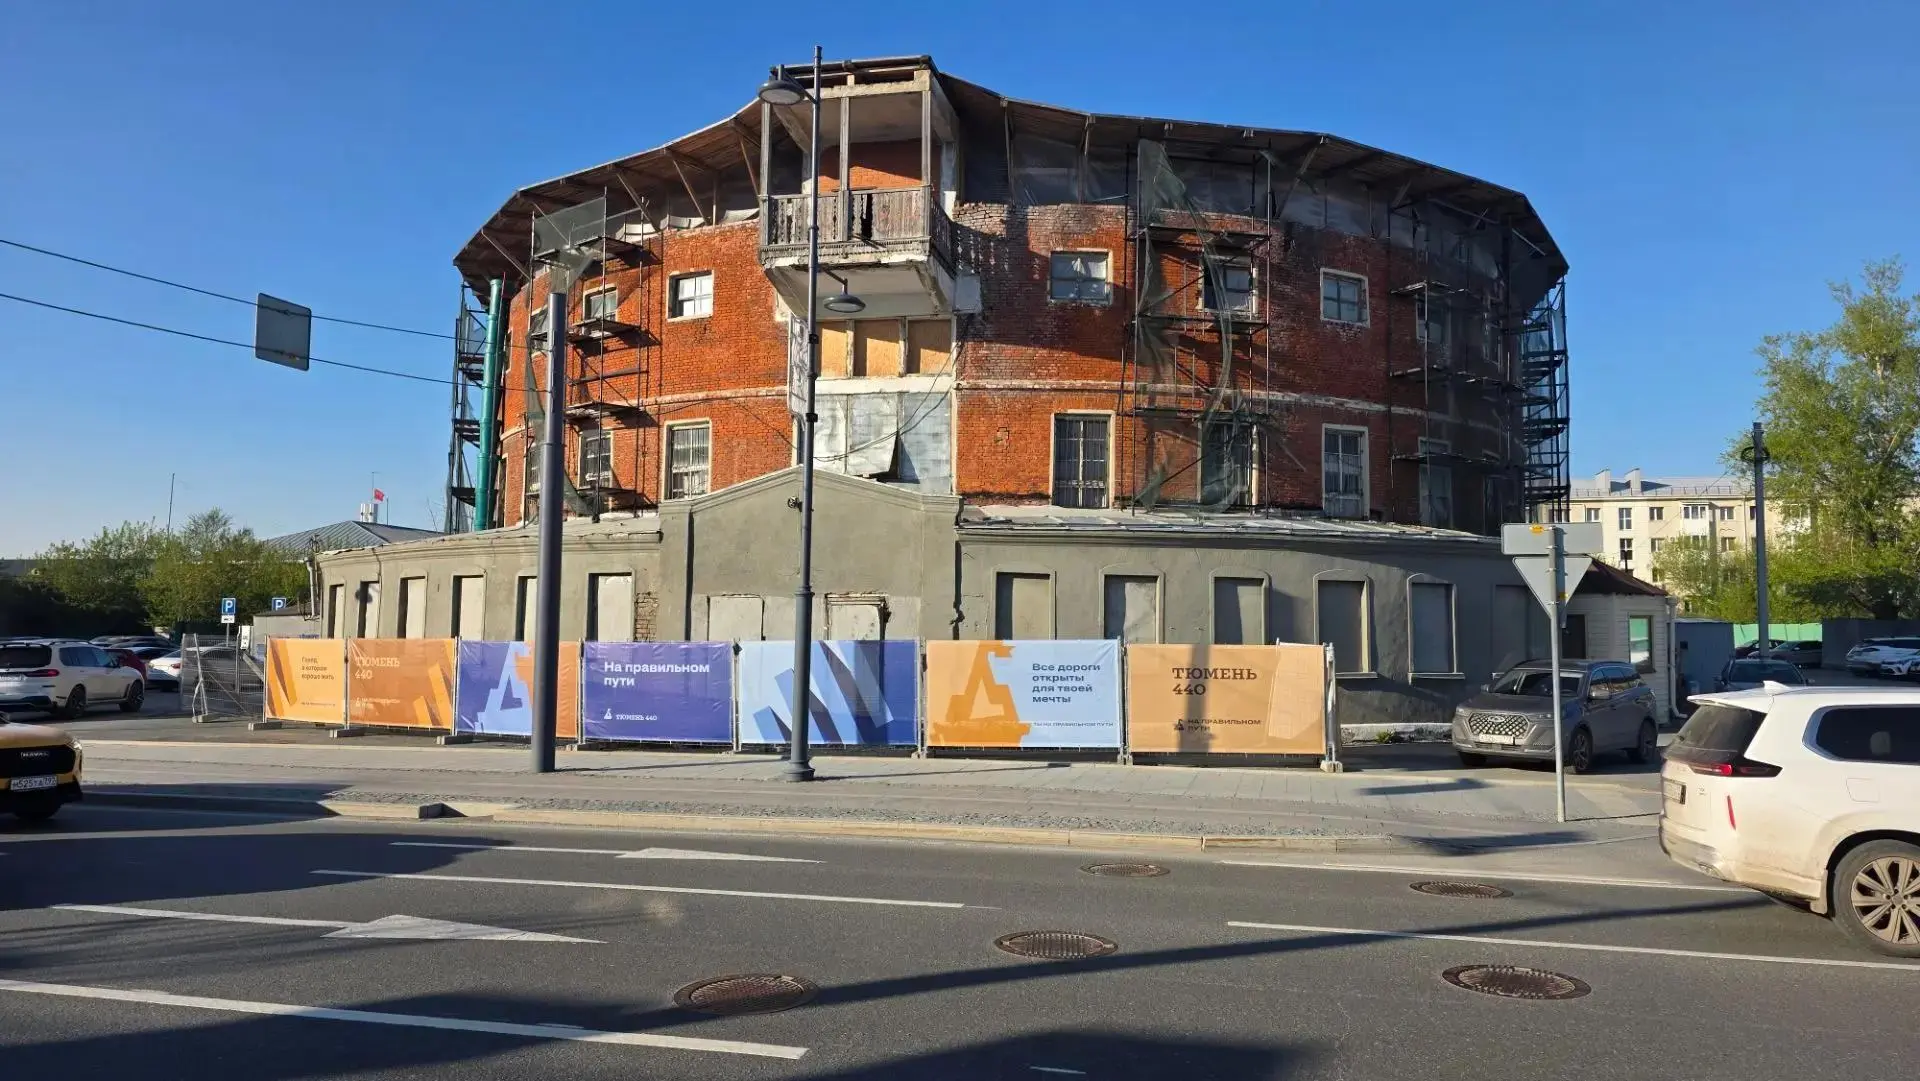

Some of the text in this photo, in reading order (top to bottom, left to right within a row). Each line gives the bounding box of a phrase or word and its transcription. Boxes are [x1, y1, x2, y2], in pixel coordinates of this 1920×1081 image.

[225, 600, 233, 612] P
[276, 600, 284, 610] P
[355, 656, 400, 667] ТЮМЕНЬ
[1032, 663, 1055, 671] Все
[604, 662, 710, 674] На правильном
[355, 670, 372, 679] 440
[1172, 668, 1257, 680] ТЮМЕНЬ
[604, 676, 635, 688] пути
[1057, 684, 1093, 692] твоей
[1172, 684, 1206, 695] 440
